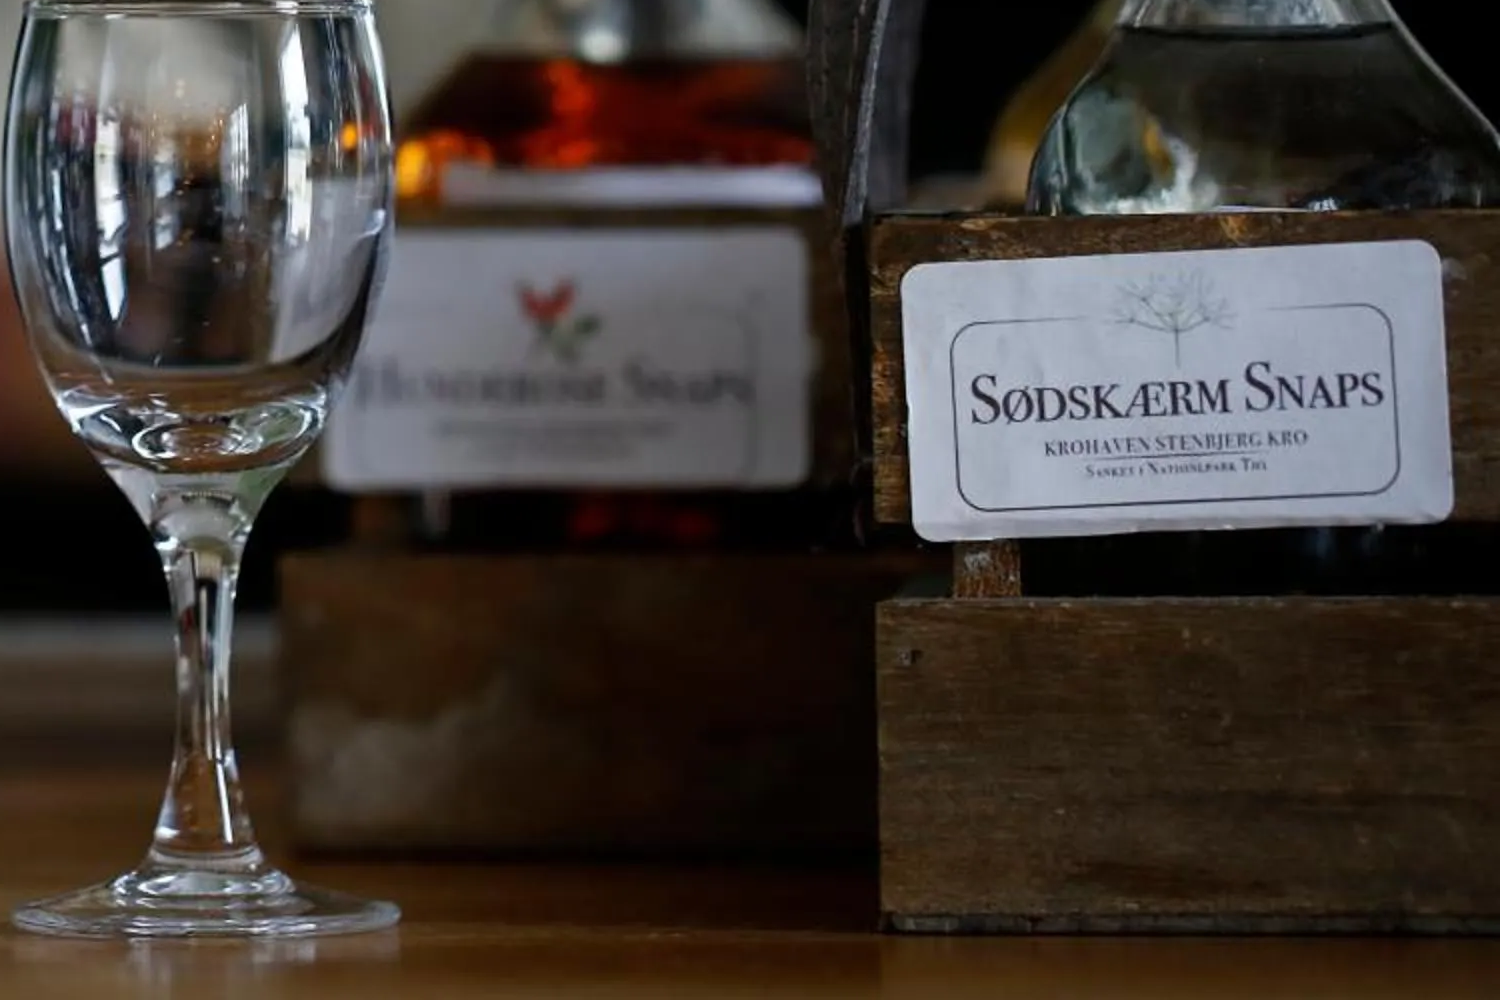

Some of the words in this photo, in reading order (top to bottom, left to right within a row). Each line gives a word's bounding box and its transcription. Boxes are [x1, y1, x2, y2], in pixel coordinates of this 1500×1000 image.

[970, 373, 1232, 426] SØDSKÆRM
[1244, 360, 1384, 412] SNAPS
[1044, 436, 1151, 456] KROHAVEN
[1154, 430, 1263, 452] STENBJERG
[1267, 428, 1310, 446] KRO
